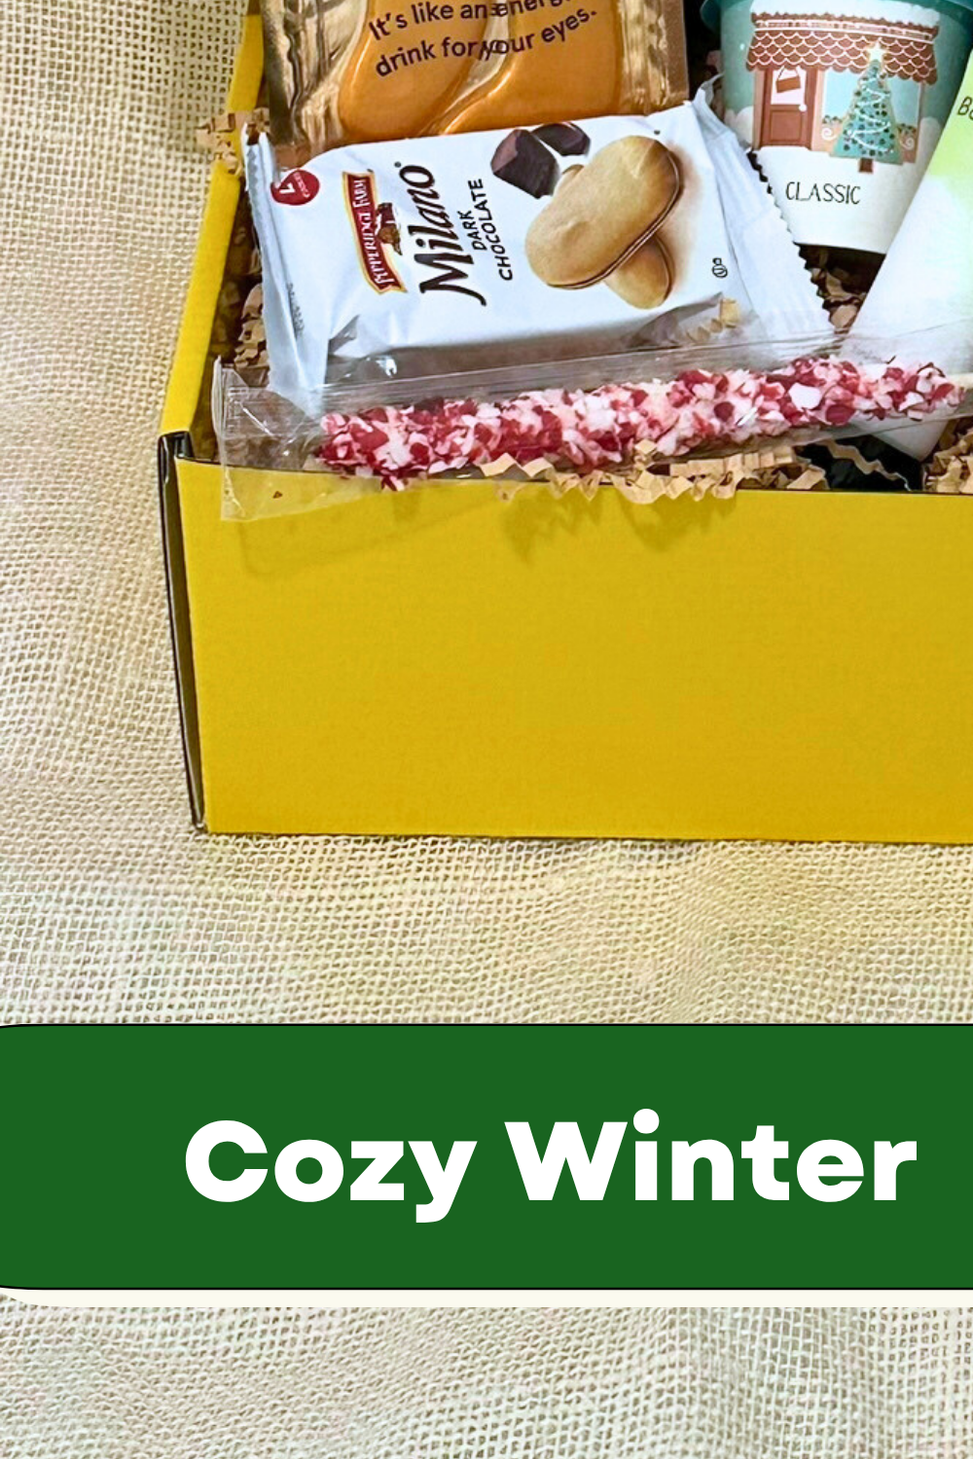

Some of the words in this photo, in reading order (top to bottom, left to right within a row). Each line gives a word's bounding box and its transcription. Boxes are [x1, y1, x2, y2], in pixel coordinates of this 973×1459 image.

[368, 10, 408, 41] It's
[410, 1, 454, 25] like
[460, 3, 488, 20] an
[375, 40, 436, 78] drink
[442, 36, 478, 58] for
[479, 33, 536, 62] your
[541, 7, 598, 43] eyes.
[785, 180, 862, 205] CLASSIC
[398, 164, 488, 307] Milano
[456, 210, 488, 251] DARK
[467, 178, 514, 282] CHOCOLATE
